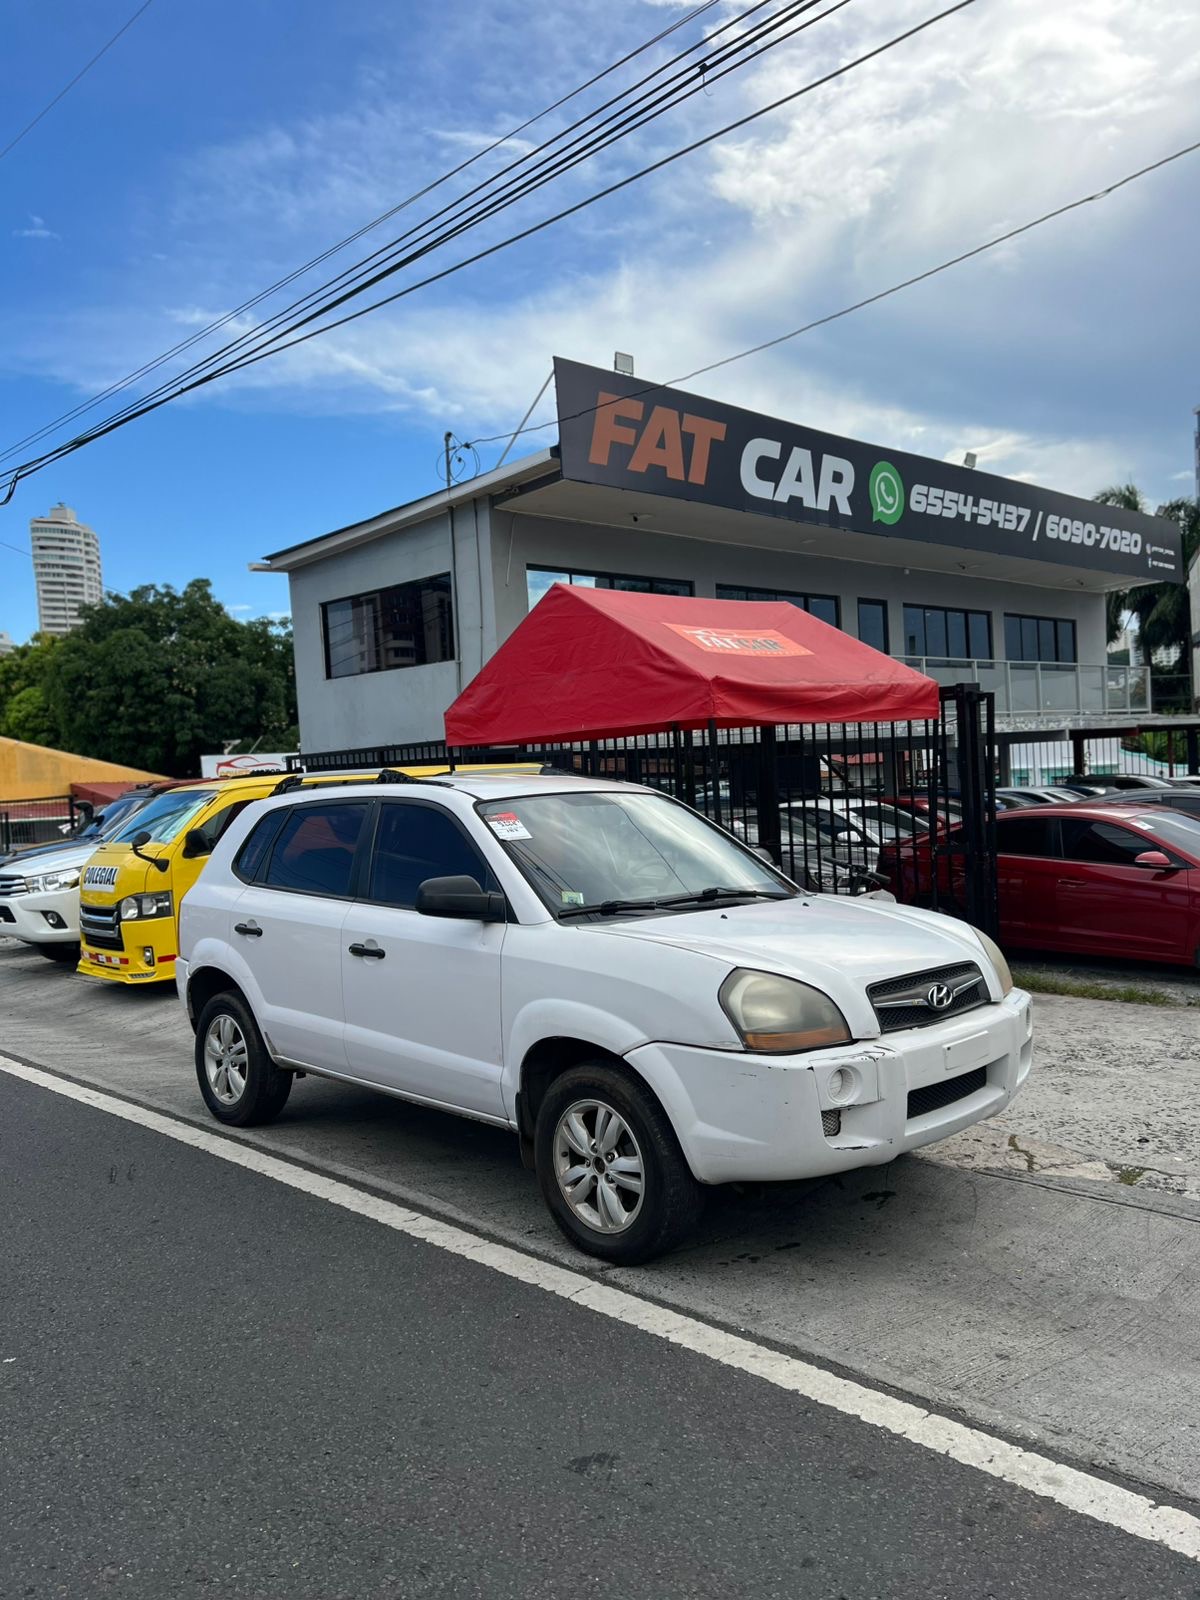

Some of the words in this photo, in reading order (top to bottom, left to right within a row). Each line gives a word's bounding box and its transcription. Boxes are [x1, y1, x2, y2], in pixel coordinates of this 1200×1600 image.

[588, 391, 728, 486] FAT
[740, 437, 856, 517] CAR
[909, 483, 1032, 533] 6554-5437
[1045, 514, 1143, 556] 6090-7020
[84, 866, 118, 886] COLEGIAL
